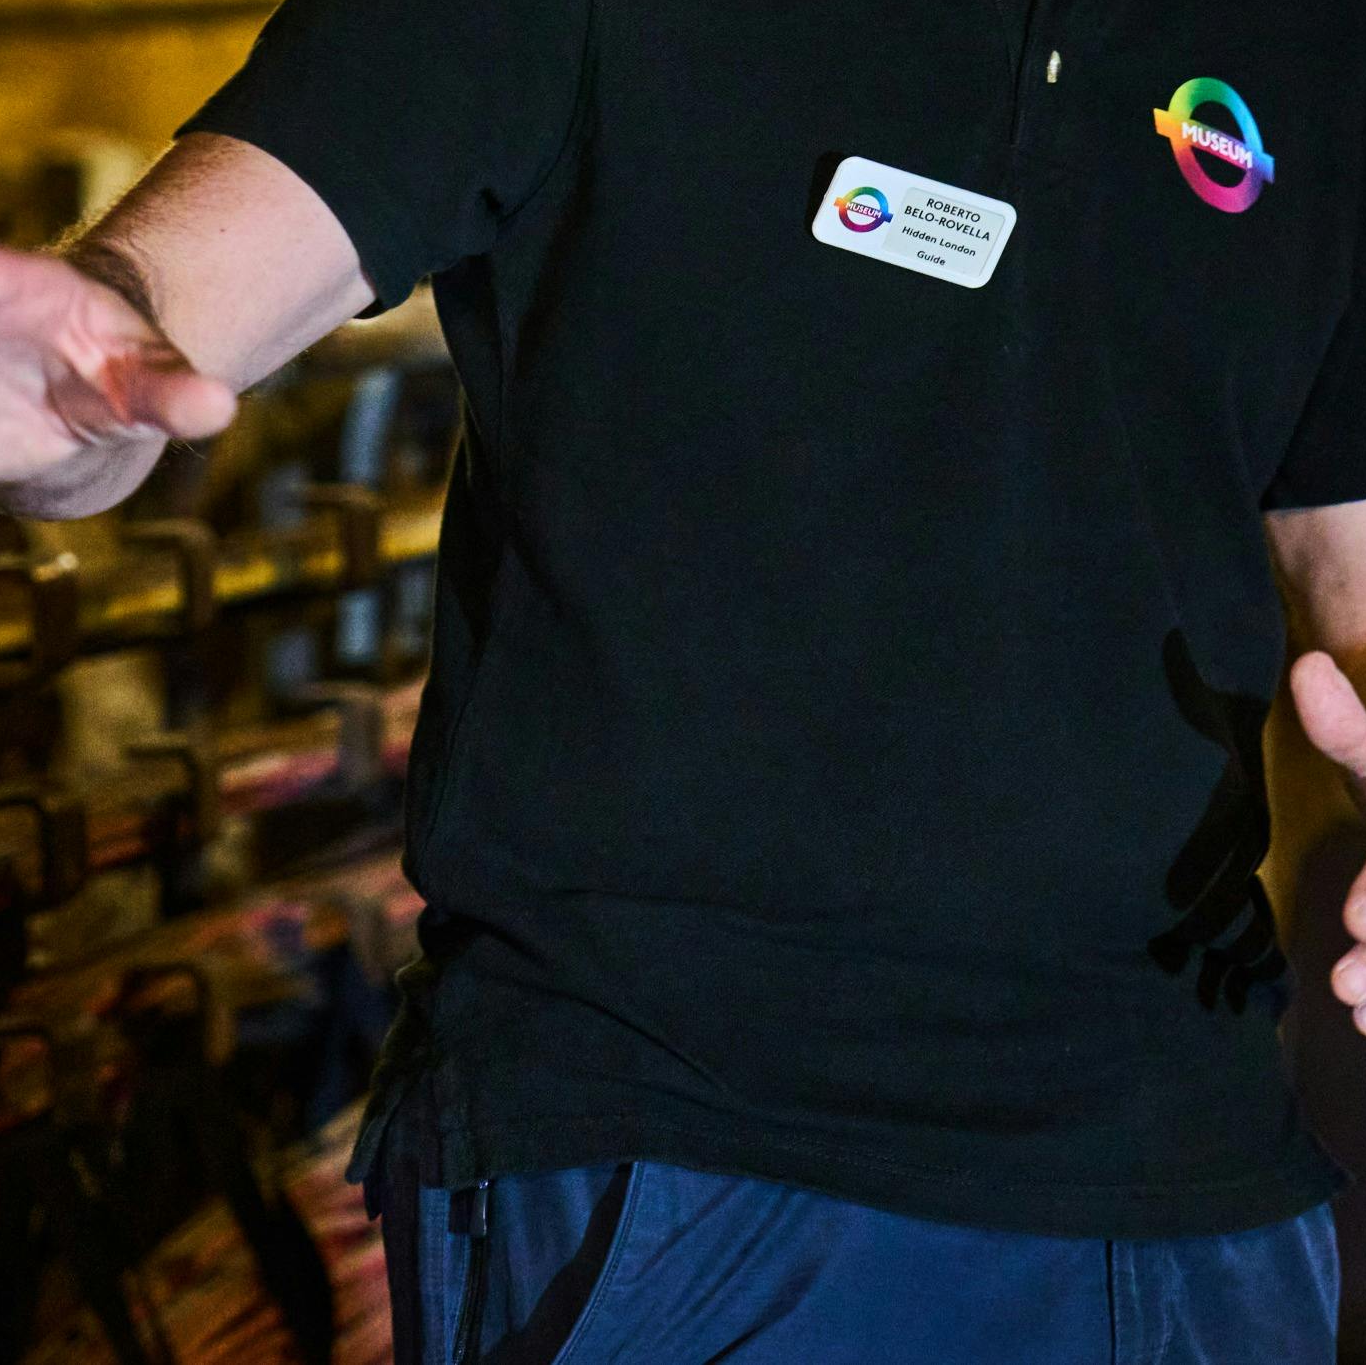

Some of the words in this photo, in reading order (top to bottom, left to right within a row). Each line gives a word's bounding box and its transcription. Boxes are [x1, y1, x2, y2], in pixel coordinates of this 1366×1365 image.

[1181, 122, 1253, 169] MUSEUM
[845, 201, 883, 220] MUSEUM
[904, 205, 990, 242] BELO-ROVELLA
[926, 198, 981, 223] ROBERTO
[901, 226, 938, 245] Hidden
[939, 238, 977, 257] London
[916, 250, 946, 266] Guide
